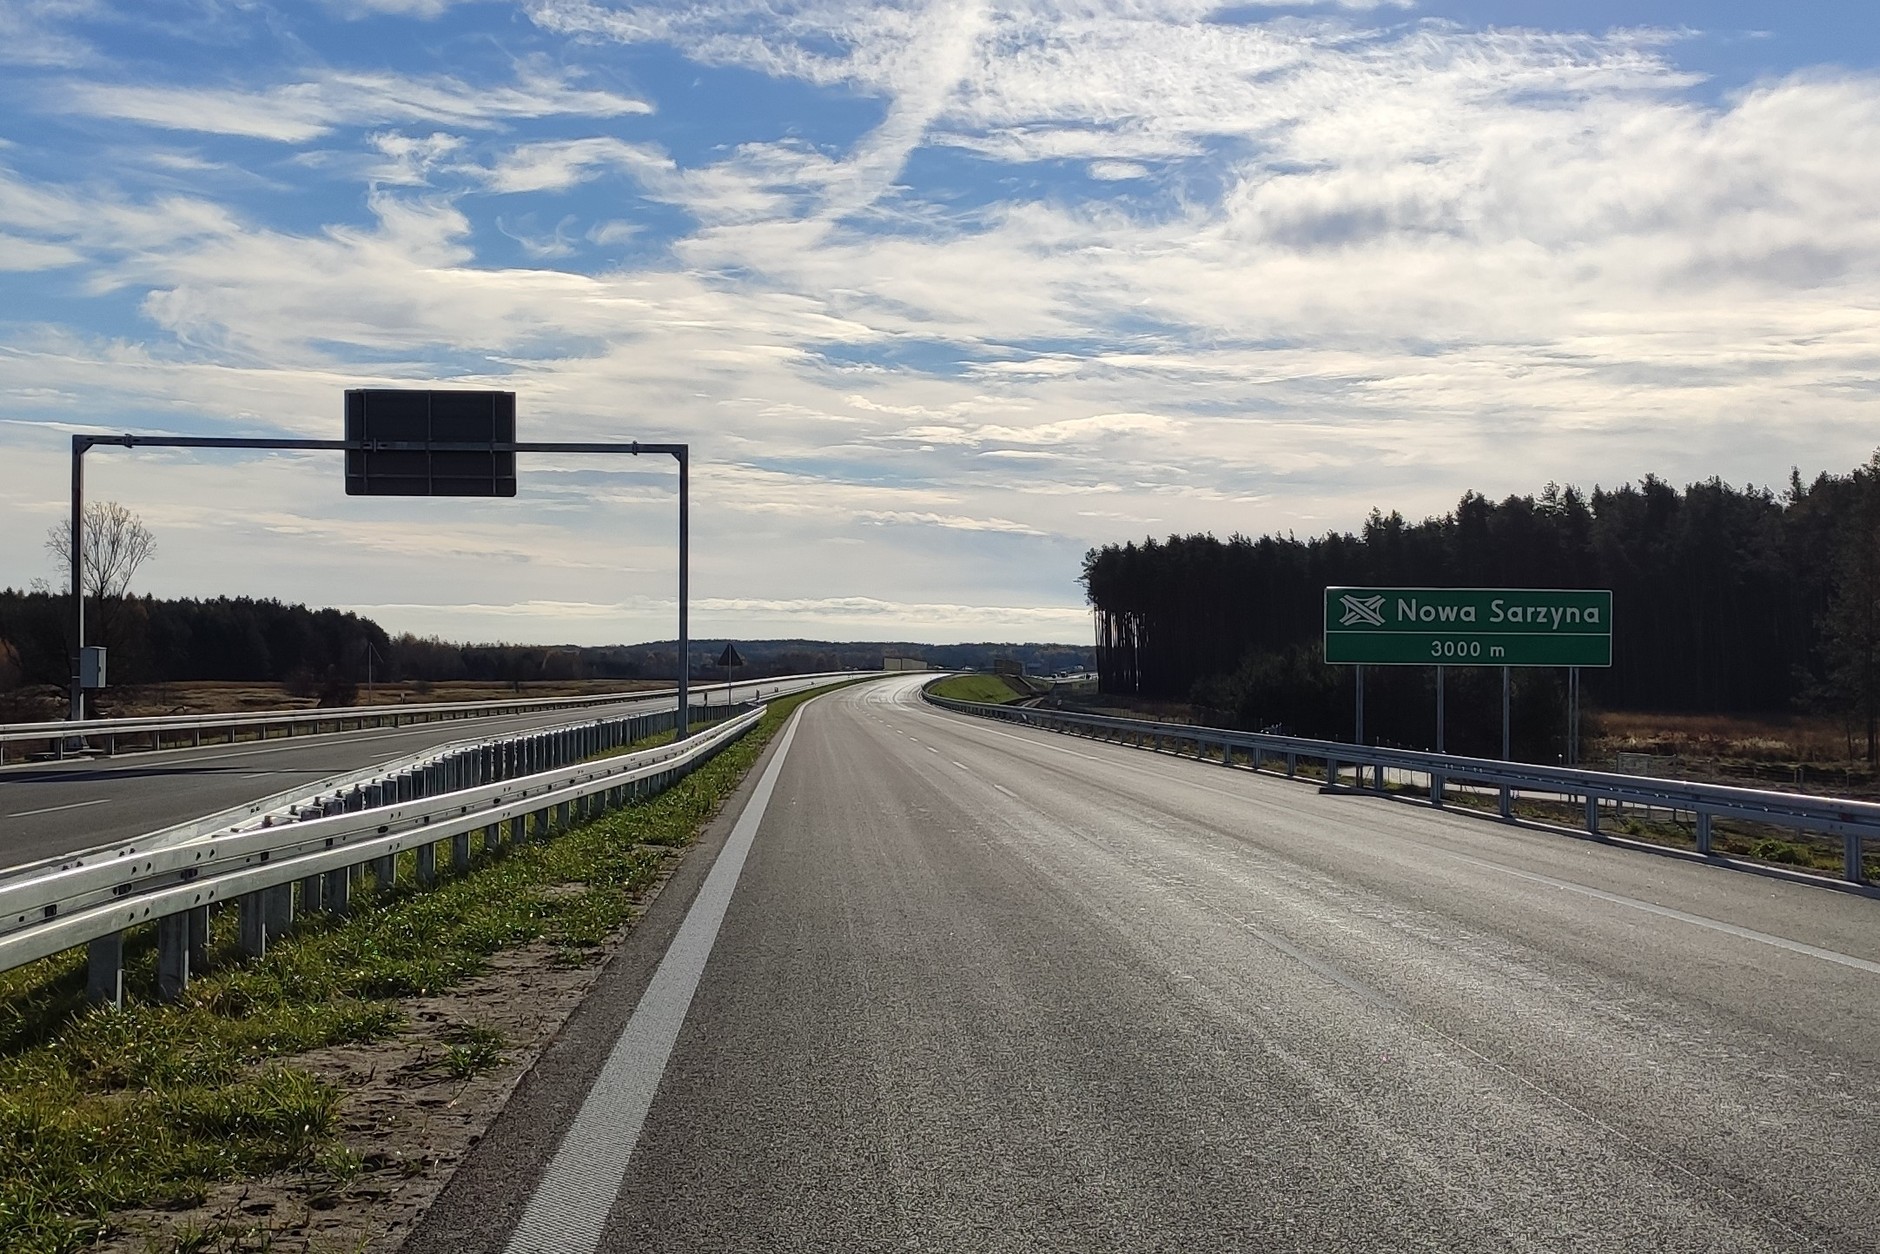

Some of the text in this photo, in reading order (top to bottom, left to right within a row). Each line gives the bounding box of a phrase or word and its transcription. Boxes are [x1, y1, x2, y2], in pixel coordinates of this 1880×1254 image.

[1397, 598, 1600, 630] Nowa Sarzyna
[1430, 641, 1505, 657] 3000 m
